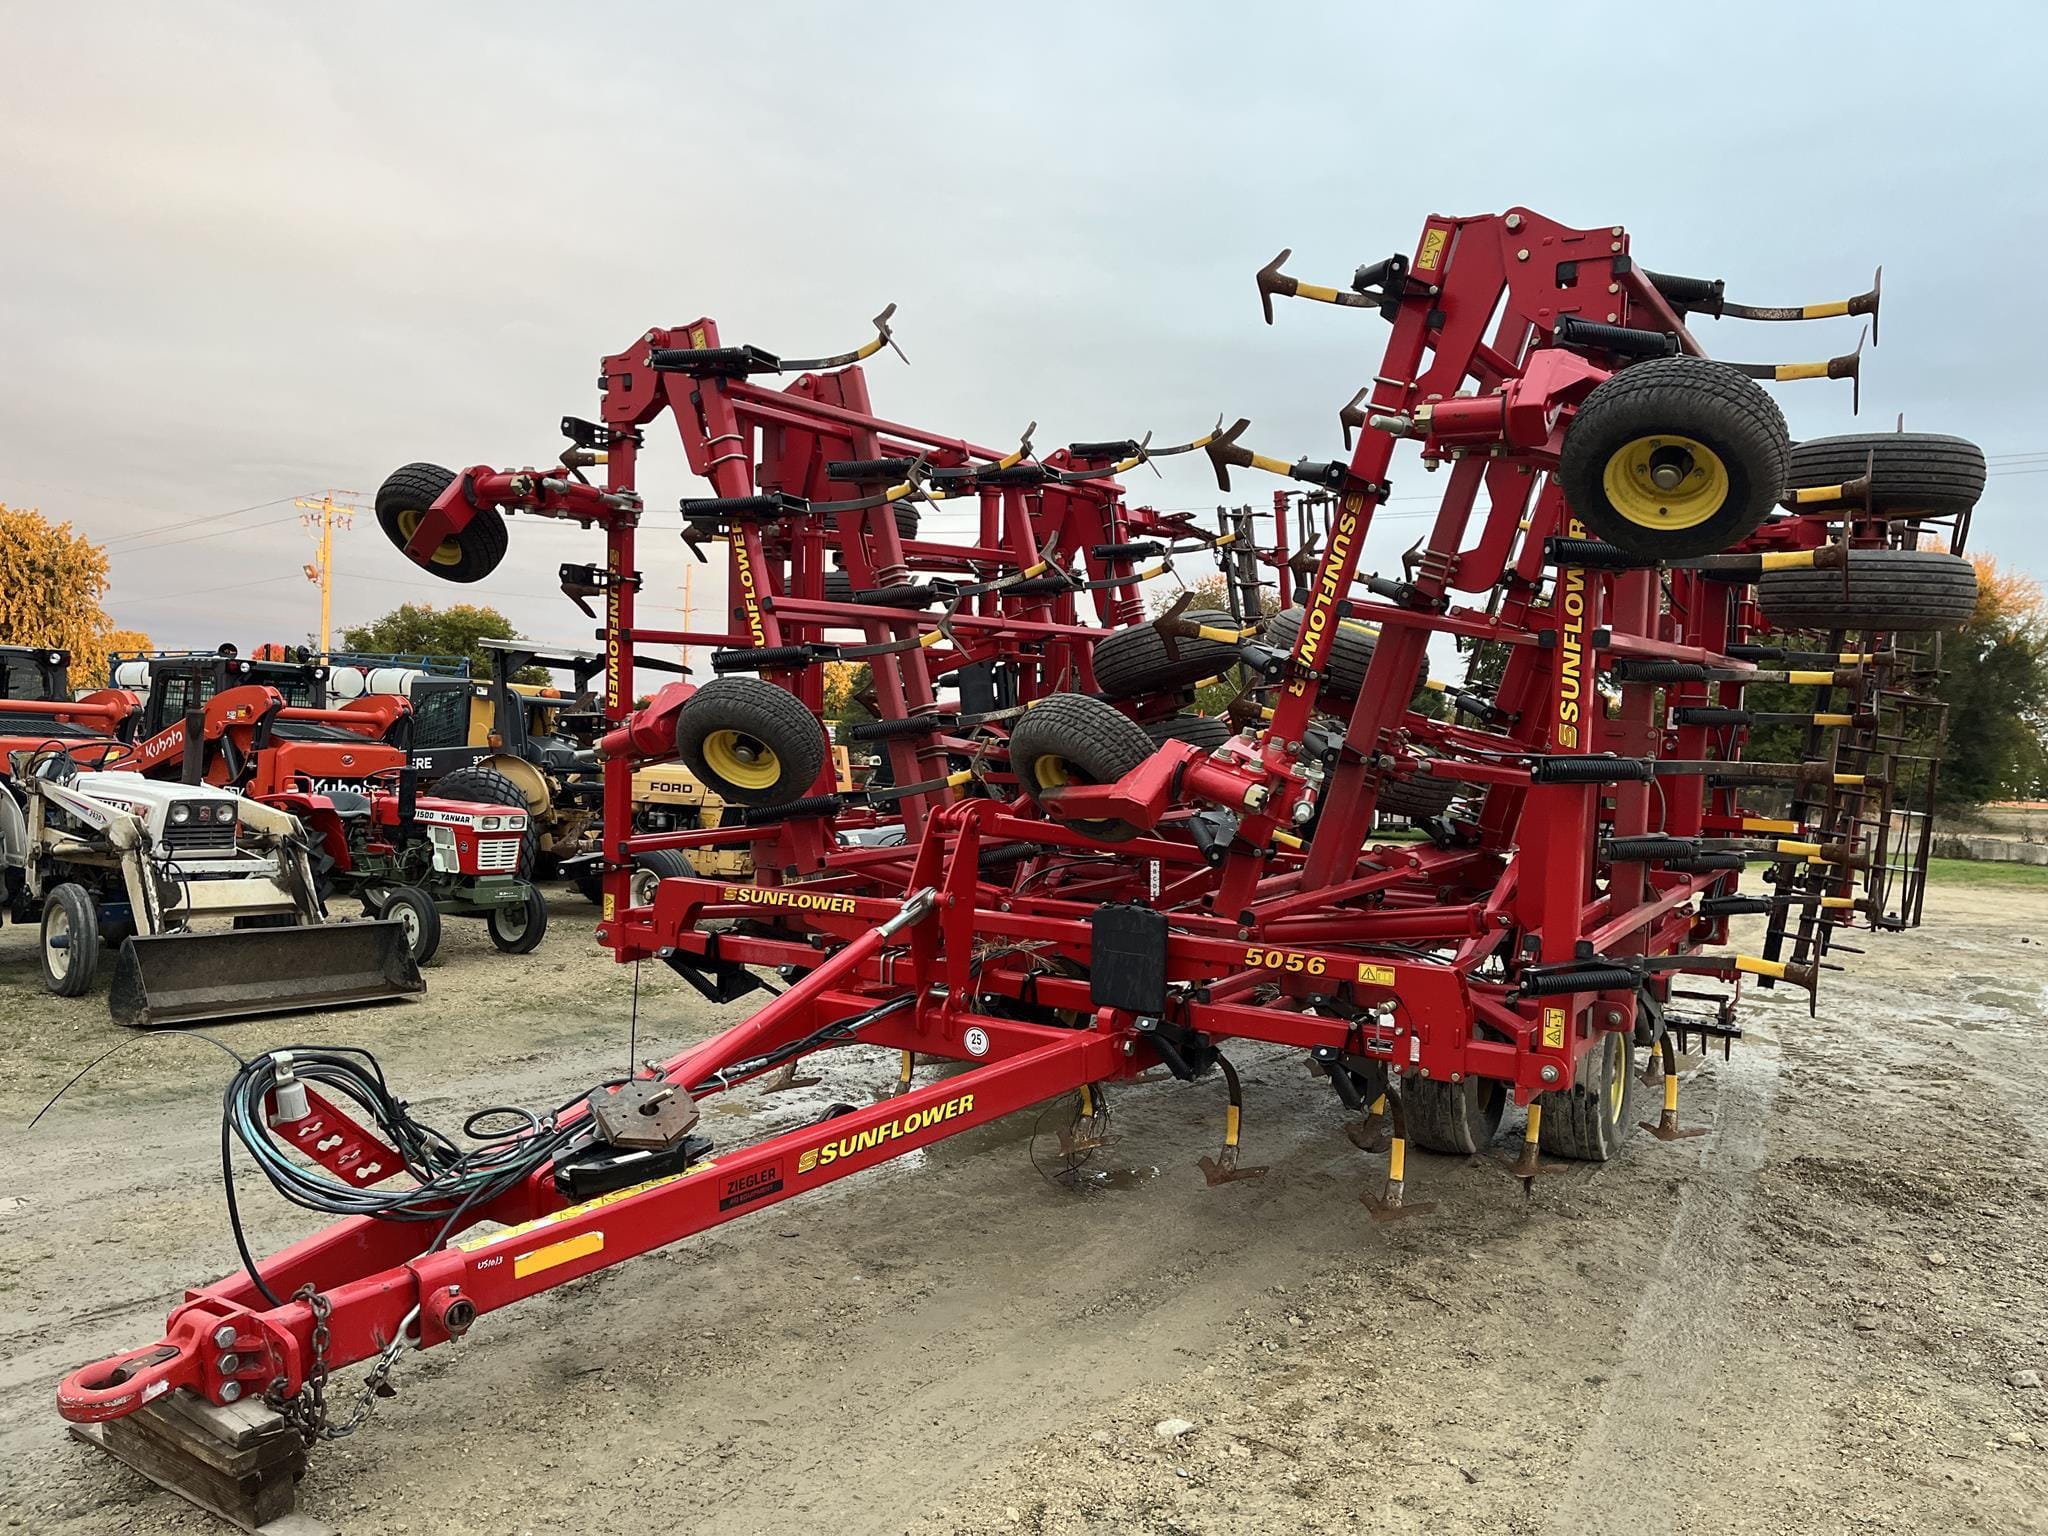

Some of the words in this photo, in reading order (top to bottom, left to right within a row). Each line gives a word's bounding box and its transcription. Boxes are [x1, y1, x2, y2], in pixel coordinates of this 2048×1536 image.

[730, 519, 766, 649] UNFLOWER
[1560, 517, 1587, 723] SUNFLOWR
[609, 567, 620, 709] UNFLOWER
[145, 729, 184, 758] Kubota
[650, 782, 693, 794] FORD
[441, 813, 471, 824] YANMAR
[738, 888, 857, 913] SUNFLOWER
[1244, 947, 1327, 975] 5056
[971, 1033, 982, 1045] 25
[820, 1094, 974, 1165] SUNFLOWER
[727, 1167, 776, 1195] ZIEGLER
